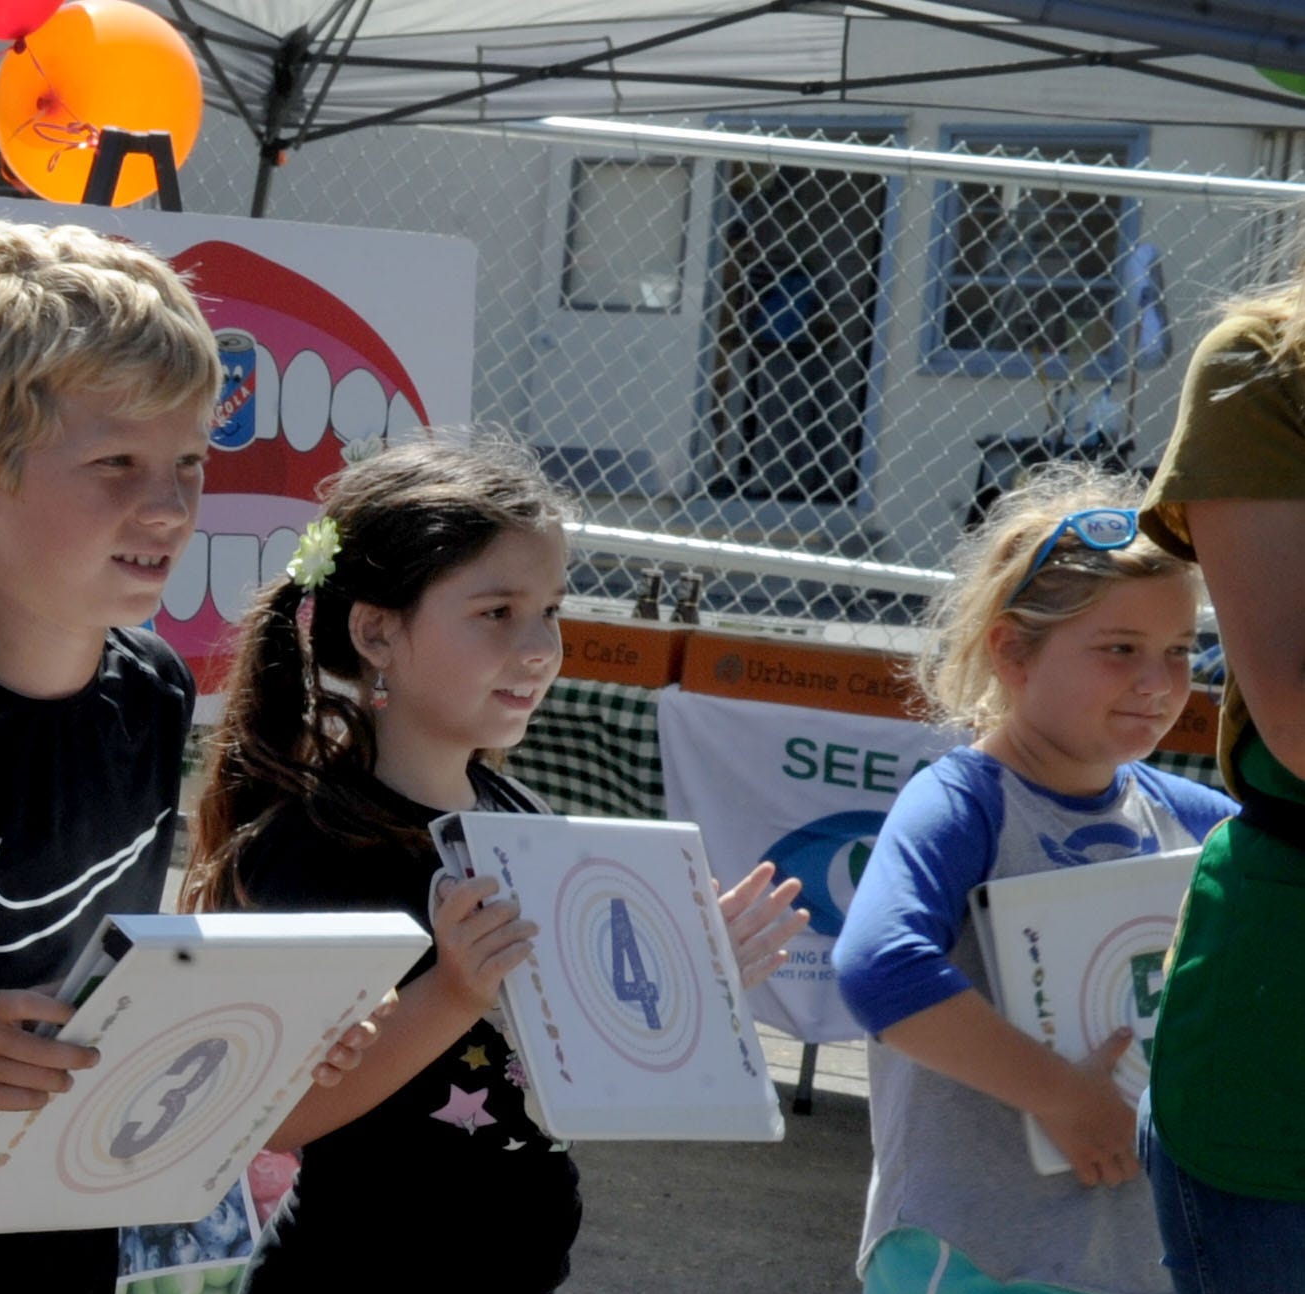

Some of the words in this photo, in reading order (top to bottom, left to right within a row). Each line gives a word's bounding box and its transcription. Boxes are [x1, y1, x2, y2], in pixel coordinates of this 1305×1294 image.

[747, 660, 838, 691] Urbane
[610, 898, 662, 1030] 4
[110, 1037, 228, 1159] 3
